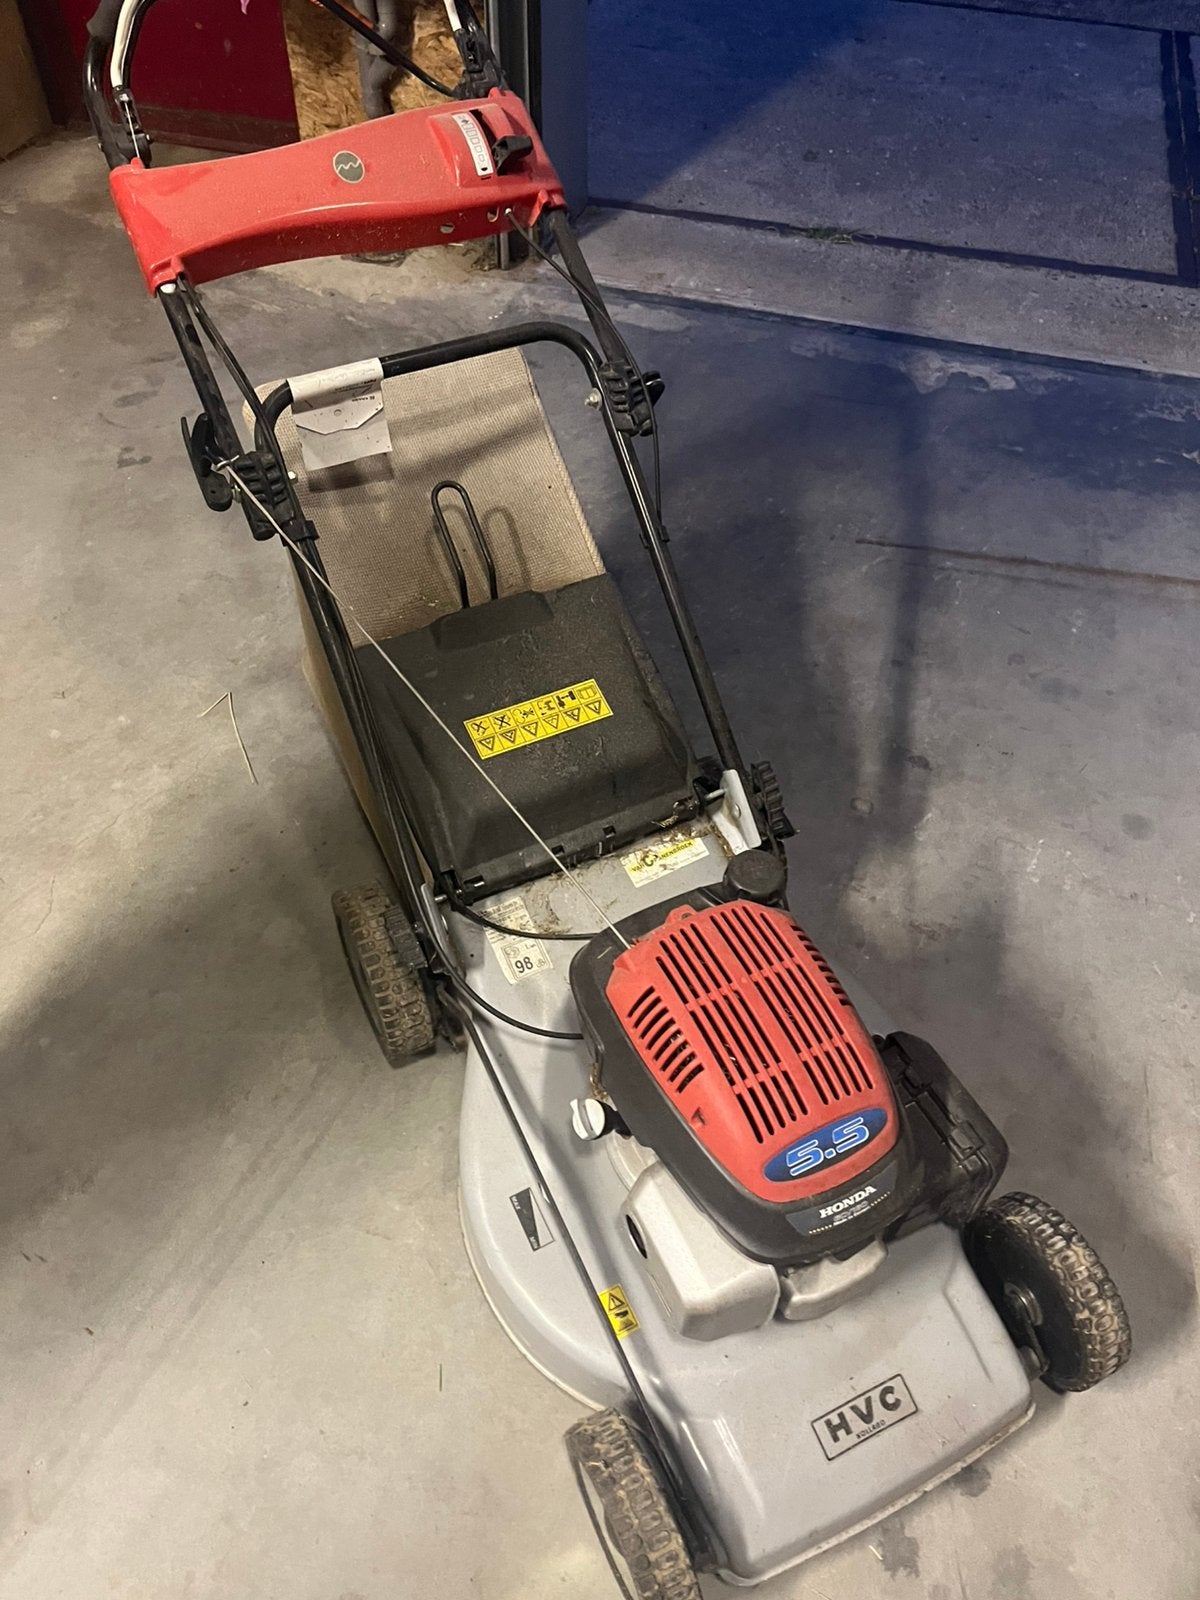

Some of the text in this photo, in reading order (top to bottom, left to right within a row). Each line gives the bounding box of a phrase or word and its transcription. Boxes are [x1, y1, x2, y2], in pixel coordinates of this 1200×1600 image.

[514, 956, 534, 974] 98
[786, 1116, 869, 1176] 5.5
[818, 1185, 878, 1219] HONDA
[823, 1385, 902, 1443] HVC
